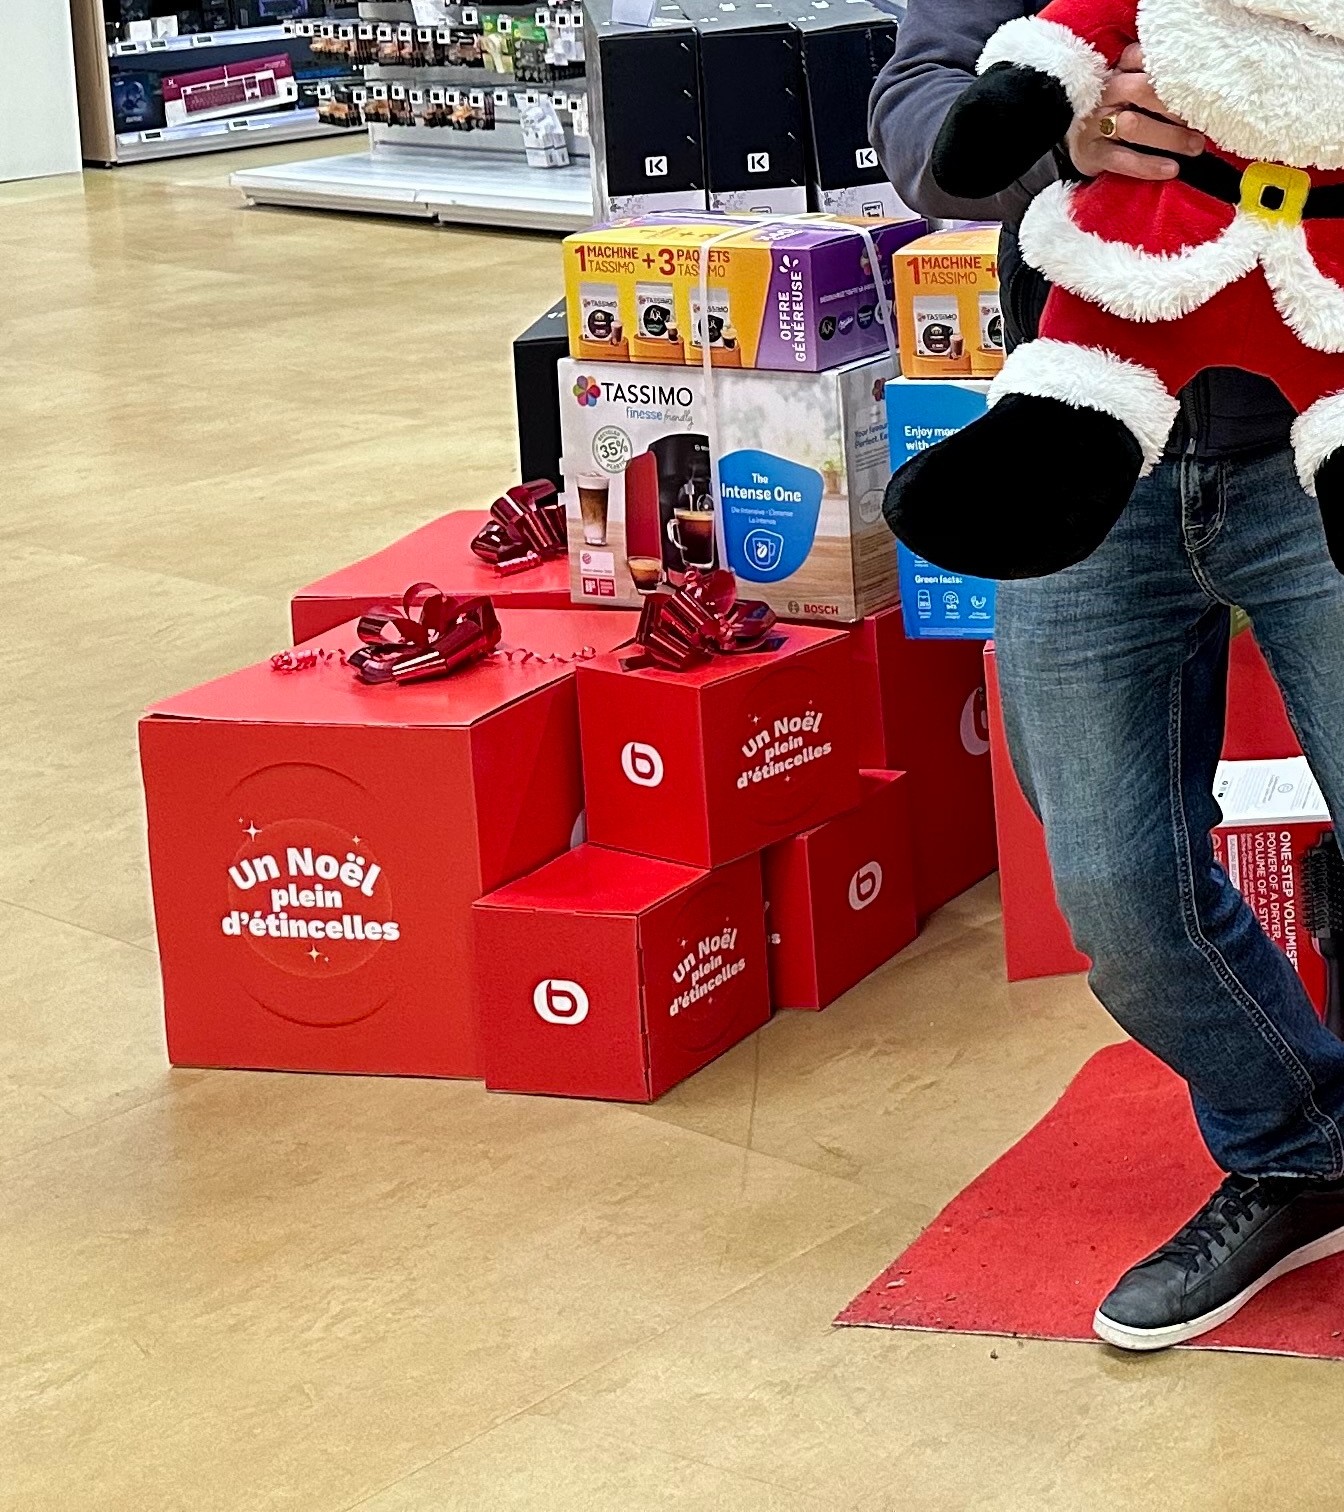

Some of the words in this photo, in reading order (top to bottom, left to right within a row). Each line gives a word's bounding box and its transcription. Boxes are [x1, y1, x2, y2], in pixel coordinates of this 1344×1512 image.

[587, 245, 639, 260] MACHINE
[676, 248, 731, 264] PAQETS
[589, 259, 635, 275] TASSIMO
[658, 248, 676, 276] 3
[921, 256, 983, 269] MACHINE
[906, 257, 921, 285] 1
[922, 270, 978, 285] TASSIMO
[778, 291, 792, 340] OFFRE
[790, 271, 807, 362] GÉNÉREUSE
[600, 382, 693, 407] TASSIMO
[626, 406, 663, 421] finesse
[904, 426, 932, 439] Enjoy
[600, 438, 629, 460] 35%
[752, 473, 769, 484] The
[721, 483, 772, 501] Intense
[774, 486, 802, 503] One
[803, 604, 839, 615] BOSCH
[742, 730, 770, 758] Un
[774, 711, 823, 738] Noël
[765, 736, 803, 763] plein
[737, 742, 832, 789] d'étincelles
[1255, 831, 1266, 878] VOLUME
[1266, 831, 1278, 872] POWER
[1280, 831, 1294, 898] ONE-STEP
[228, 853, 281, 890] Un
[286, 847, 381, 897] Noël
[1269, 873, 1278, 890] OF
[271, 883, 343, 913] plein
[221, 910, 400, 941] d'étincelles
[673, 953, 696, 983] Un
[698, 928, 737, 960] Noël
[691, 955, 722, 987] plein
[669, 958, 746, 1017] d'étincelles
